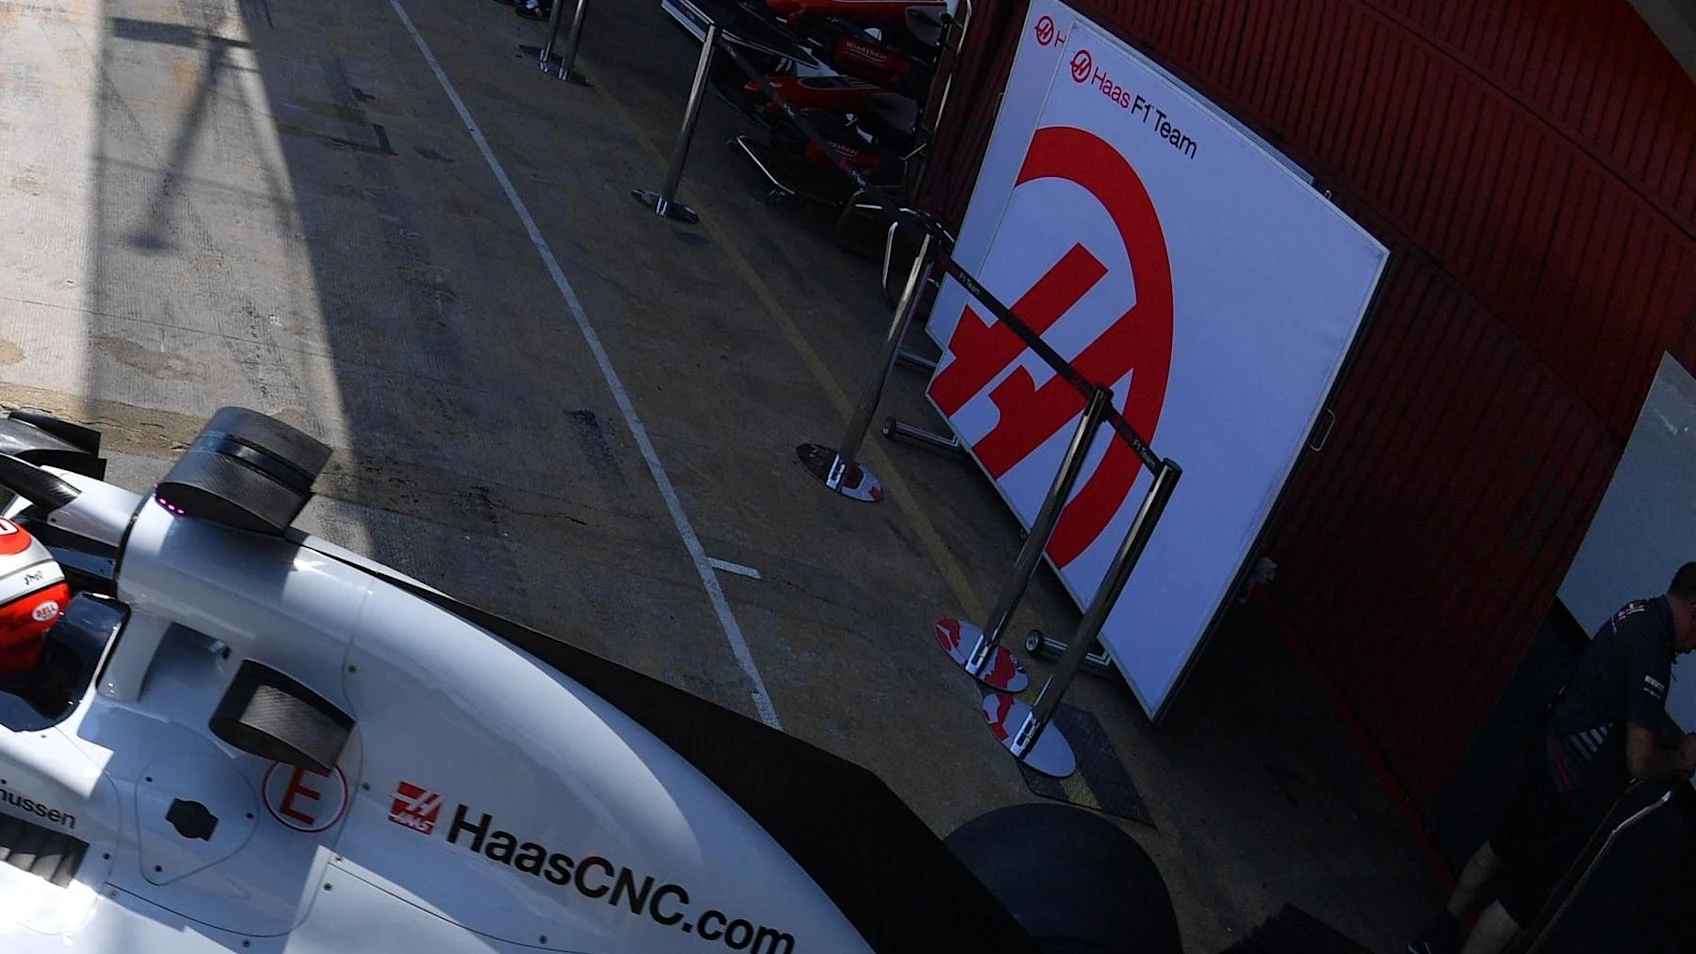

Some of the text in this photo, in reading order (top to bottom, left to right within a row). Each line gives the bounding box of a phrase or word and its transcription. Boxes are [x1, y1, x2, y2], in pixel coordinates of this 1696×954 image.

[1092, 66, 1197, 159] Haas F1 Team
[279, 767, 330, 824] E
